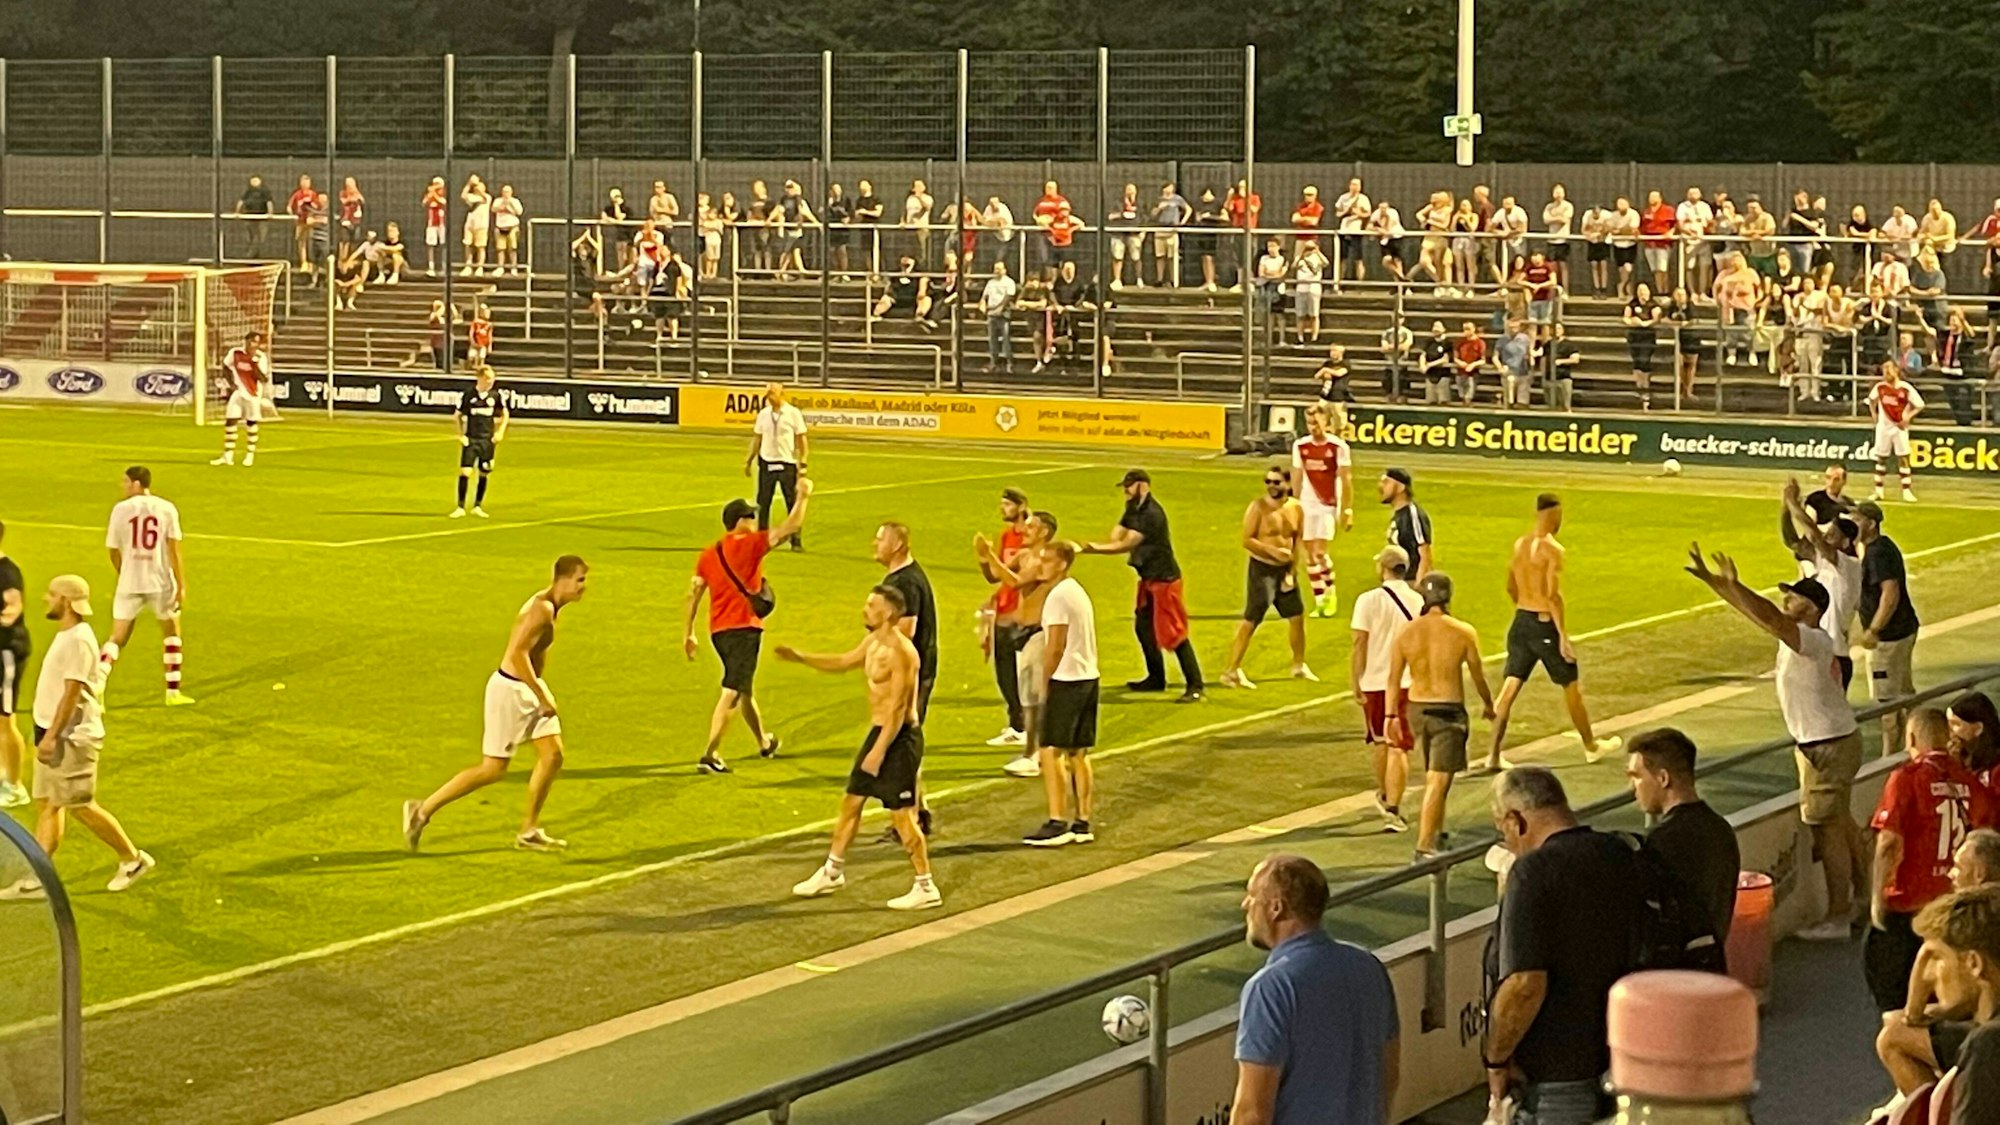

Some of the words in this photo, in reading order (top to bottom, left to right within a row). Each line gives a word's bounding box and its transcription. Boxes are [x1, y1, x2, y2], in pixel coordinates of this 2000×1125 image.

[56, 371, 95, 392] Ford
[143, 373, 183, 395] Ford
[323, 382, 381, 403] hummel
[413, 385, 464, 405] humm
[510, 390, 571, 411] hummel
[608, 393, 671, 415] hummel
[1340, 414, 1458, 447] äckerei
[1464, 419, 1638, 455] Schneider
[128, 515, 159, 550] 16
